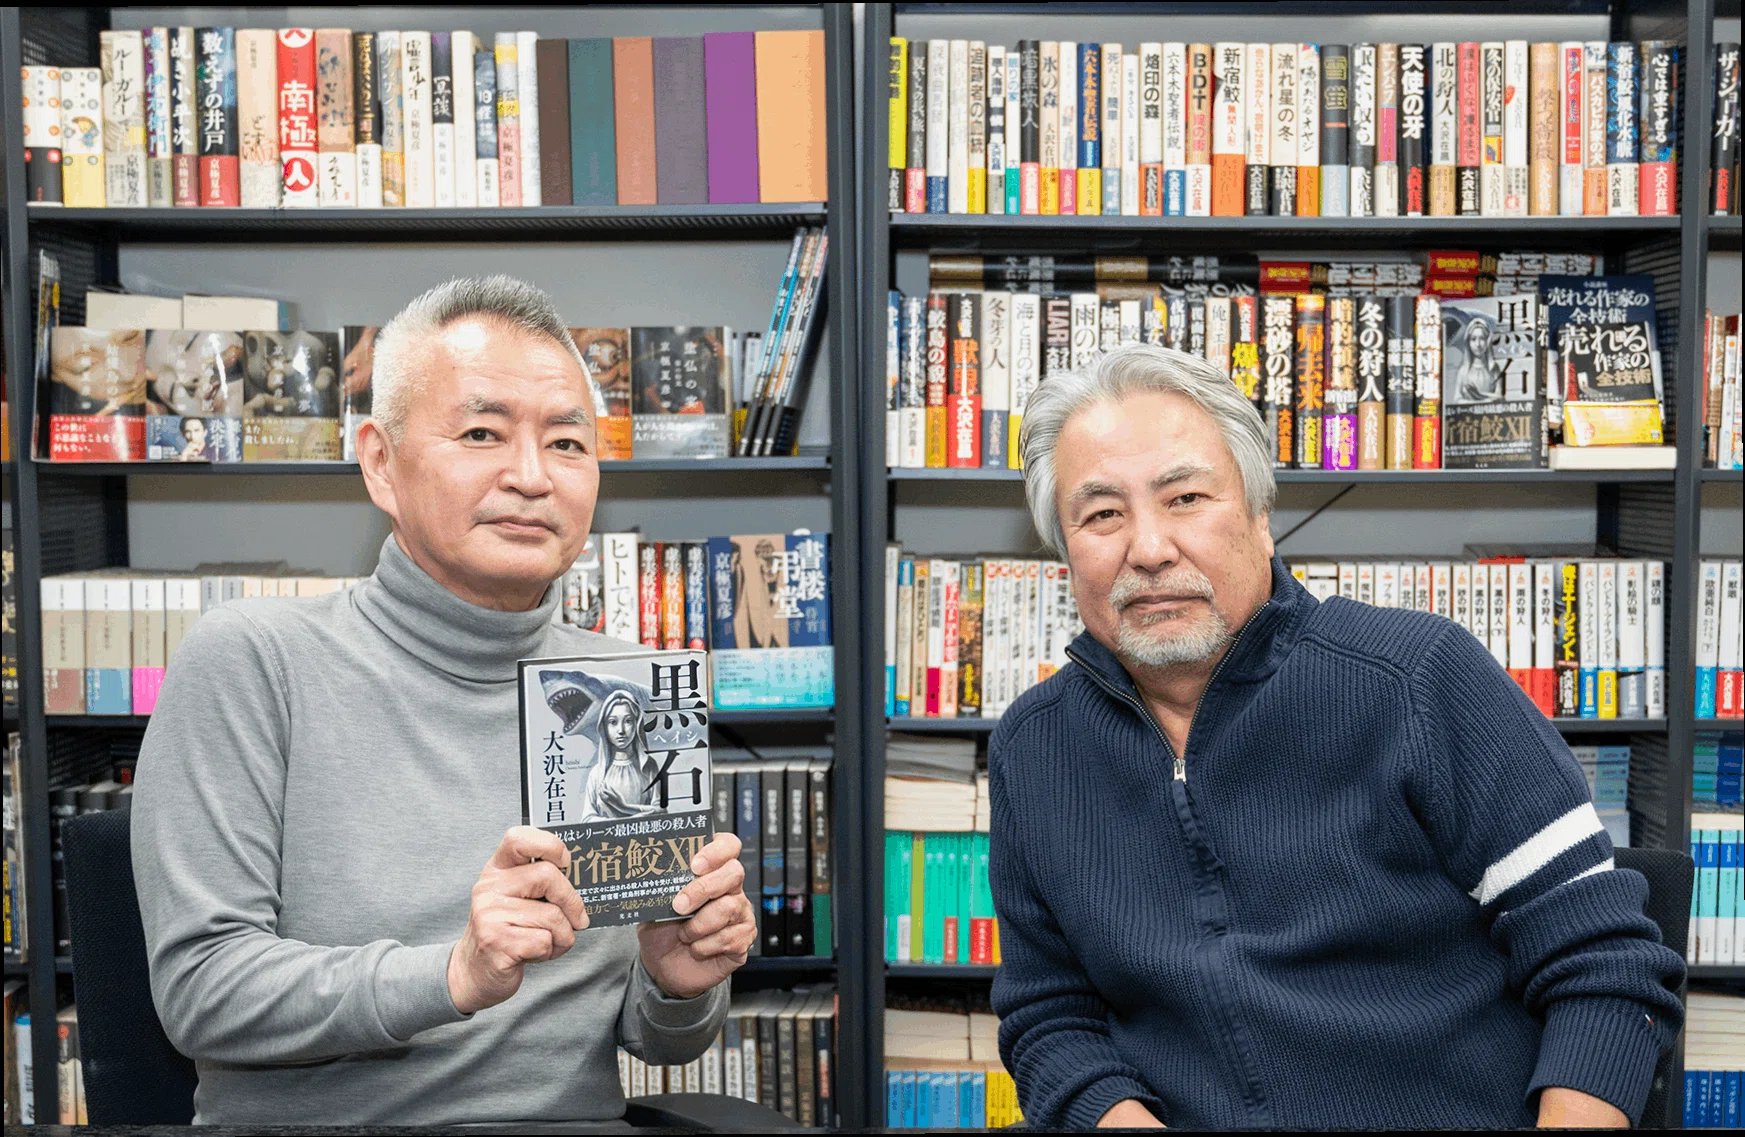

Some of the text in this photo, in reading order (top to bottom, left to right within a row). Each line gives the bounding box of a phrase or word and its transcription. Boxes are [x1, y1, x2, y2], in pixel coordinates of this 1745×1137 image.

[202, 32, 225, 152] 数えずの井戸
[1021, 49, 1039, 128] 暗黒旅人
[1042, 56, 1057, 108] 氷の森
[1144, 53, 1160, 119] 烙印の森
[1167, 52, 1181, 149] 六本木聖者伝説
[1223, 48, 1241, 103] 新宿鮫
[1278, 53, 1295, 141] 流れ星の冬
[1401, 47, 1424, 139] 天使の牙
[1435, 48, 1454, 117] 北の狩人
[1486, 48, 1502, 122] 冬の保安官
[1651, 53, 1670, 144] 心では重すぎる
[1714, 52, 1740, 150] ザ・ジョーカー
[281, 80, 316, 147] 南極
[1440, 120, 1450, 161] 大沢在昌
[1590, 76, 1603, 164] バスカビル家の犬
[127, 154, 139, 204] 京極夏彦
[179, 156, 189, 199] 京極夏彦
[209, 158, 221, 199] 京極夏彦
[503, 127, 513, 181] 京極夏彦
[1191, 168, 1202, 211] 大沢在昌
[1249, 166, 1262, 209] 大沢在昌
[1461, 169, 1475, 211] 大沢在昌
[1612, 168, 1621, 207] 大沢在昌
[1656, 166, 1668, 210] 大沢在昌
[1547, 287, 1650, 307] 売れる作家の
[1570, 309, 1627, 324] 全技術
[1264, 299, 1293, 406] 漂砂の塔
[1297, 324, 1324, 411] 帰去来
[1359, 301, 1385, 401] 冬の狩人
[1416, 299, 1441, 399] 熱風団地
[1492, 300, 1534, 400] 黒石
[1559, 324, 1648, 357] 売れる
[1594, 353, 1650, 373] 作家の
[1596, 370, 1652, 388] 全技術
[956, 398, 974, 459] 大沢在昌
[1365, 406, 1378, 459] 大沢在昌
[611, 538, 631, 634] ヒトでな
[715, 552, 733, 620] 京極夏彦
[772, 538, 826, 619] 書楼 弔堂
[1516, 589, 1526, 626] 雨の狩人
[1541, 589, 1550, 626] 冬の狩人
[1627, 579, 1638, 625] 影絵の騎士
[1653, 674, 1661, 705] 大沢在昌
[641, 659, 708, 809] 黒石
[653, 732, 699, 745] ヘイシ
[543, 730, 567, 823] 大沢在昌
